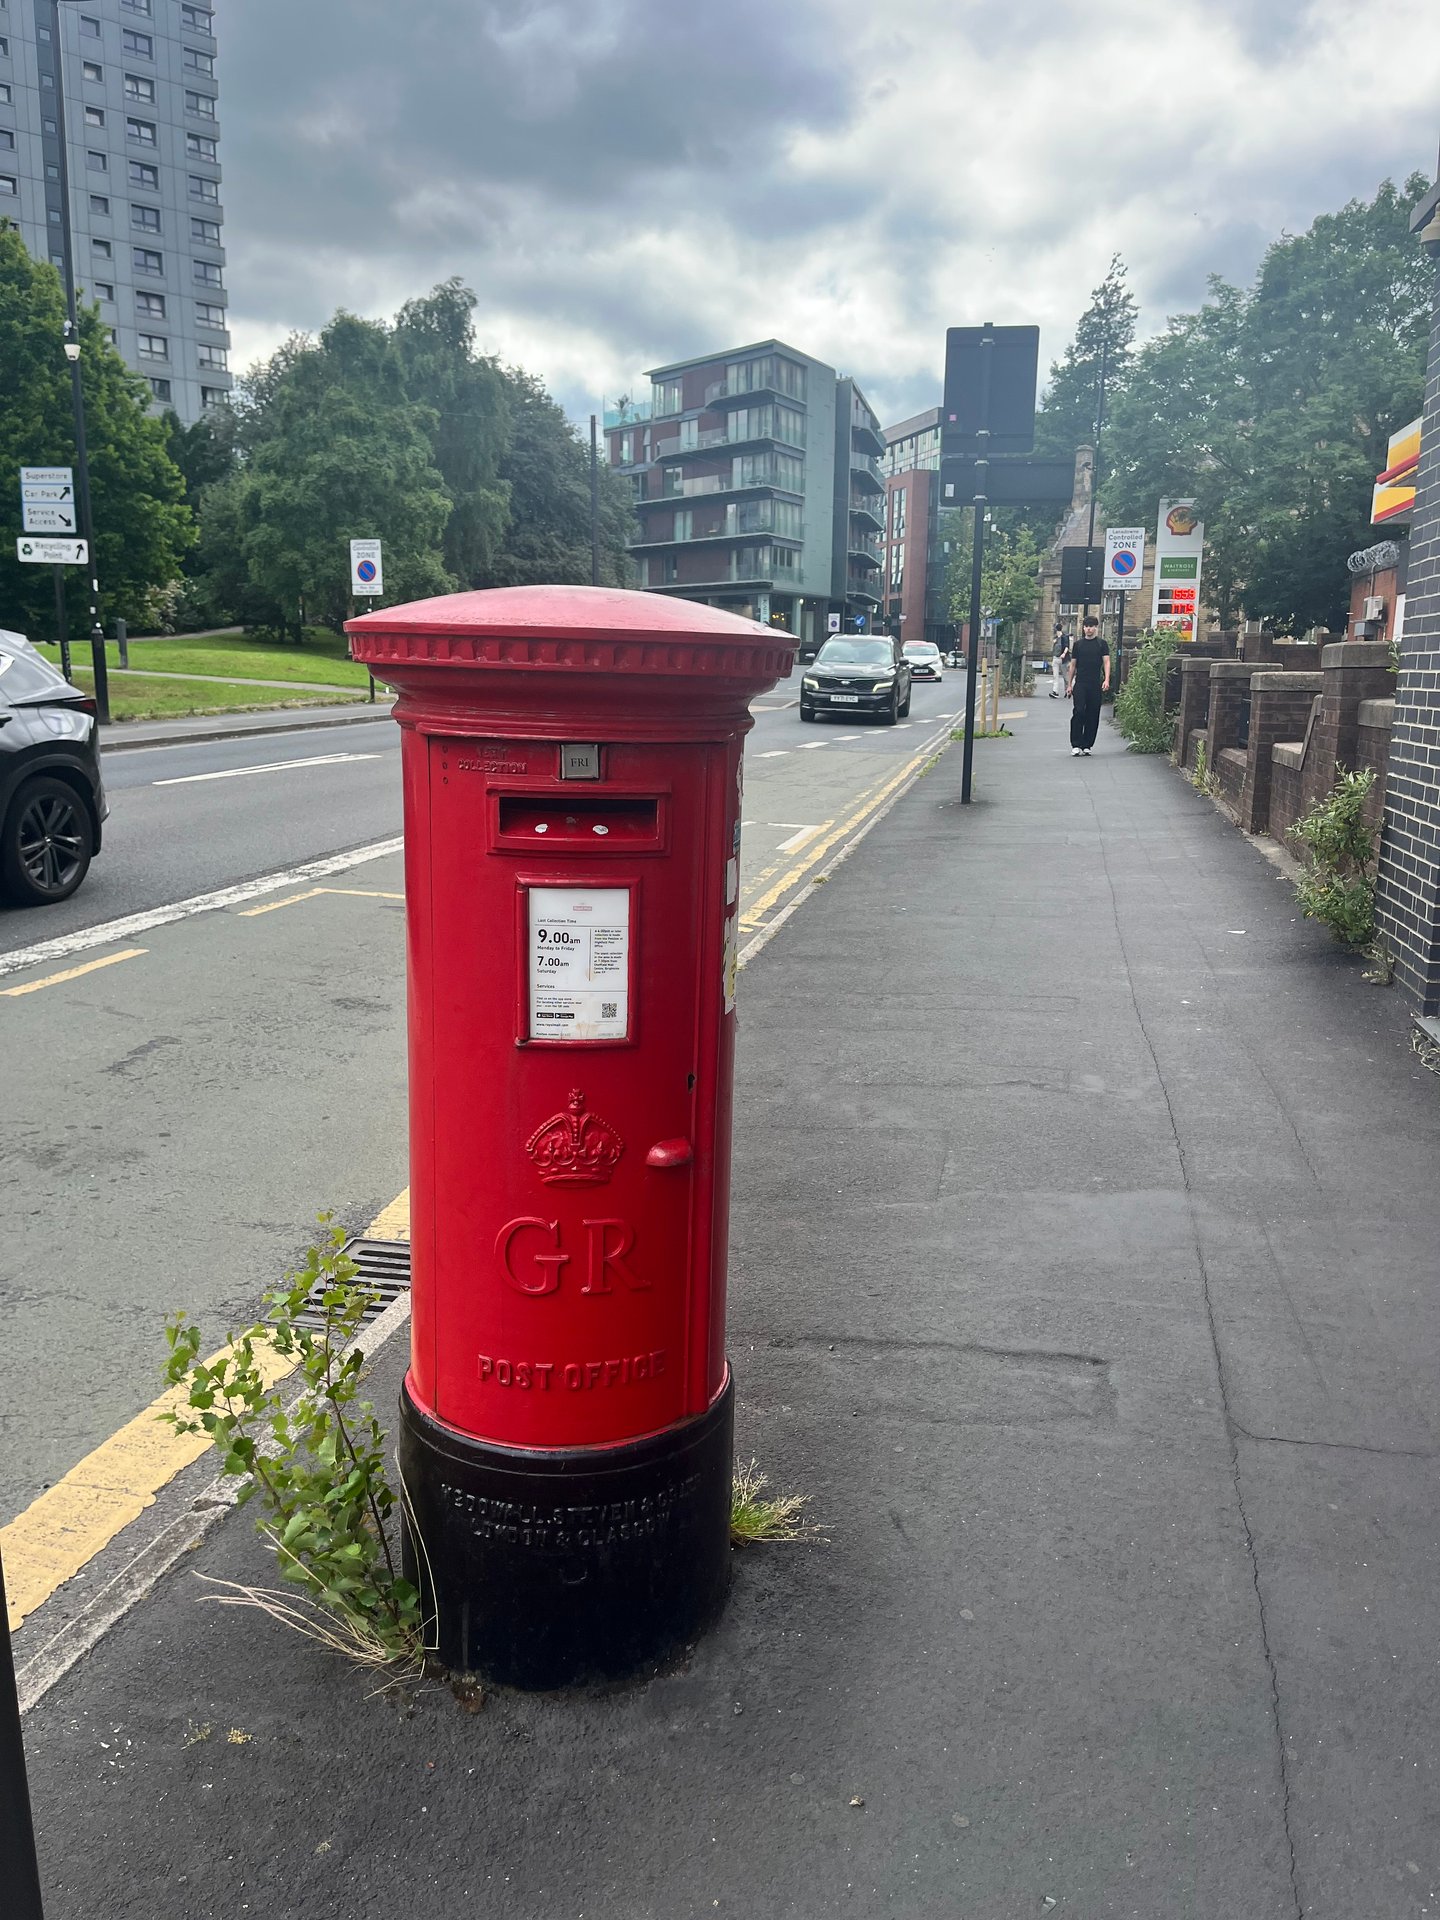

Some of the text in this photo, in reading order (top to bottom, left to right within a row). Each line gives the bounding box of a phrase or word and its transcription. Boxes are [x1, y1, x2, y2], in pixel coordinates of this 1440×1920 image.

[25, 472, 67, 480] Superstore
[27, 508, 55, 516] Service
[34, 542, 72, 551] Recycling
[458, 758, 528, 775] COLLECTION
[570, 757, 589, 767] FRI
[538, 929, 581, 944] 9.00am
[537, 956, 570, 967] 7.00am
[477, 1349, 666, 1391] POST OFFICE
